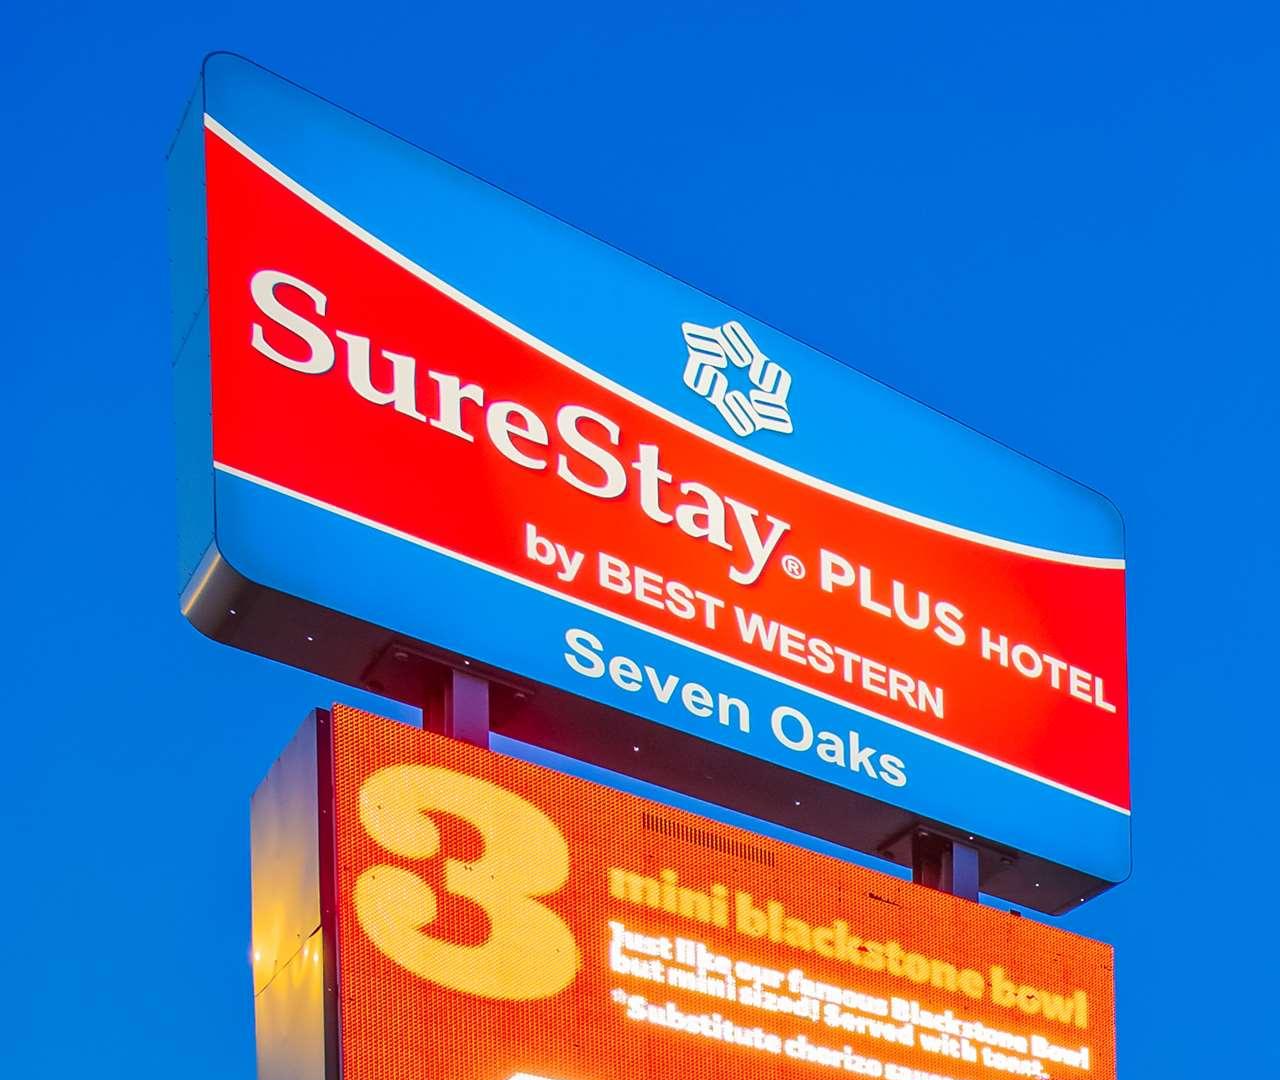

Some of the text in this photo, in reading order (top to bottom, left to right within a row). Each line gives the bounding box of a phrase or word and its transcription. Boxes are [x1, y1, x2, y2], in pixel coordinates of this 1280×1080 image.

[525, 522, 944, 720] by BEST WESTERN
[820, 547, 967, 647] PLUS
[980, 626, 1117, 714] HOTEL
[564, 628, 908, 788] Seven Oaks
[352, 763, 583, 1001] 3
[607, 866, 1088, 1030] mini blackstone bowl
[608, 921, 1089, 1070] Just like our famous Blackstone Bowl
[609, 948, 666, 983] but
[668, 967, 737, 1001] mini
[824, 1003, 914, 1047] Served
[919, 1035, 978, 1062] with
[784, 1034, 883, 1077] chorizo
